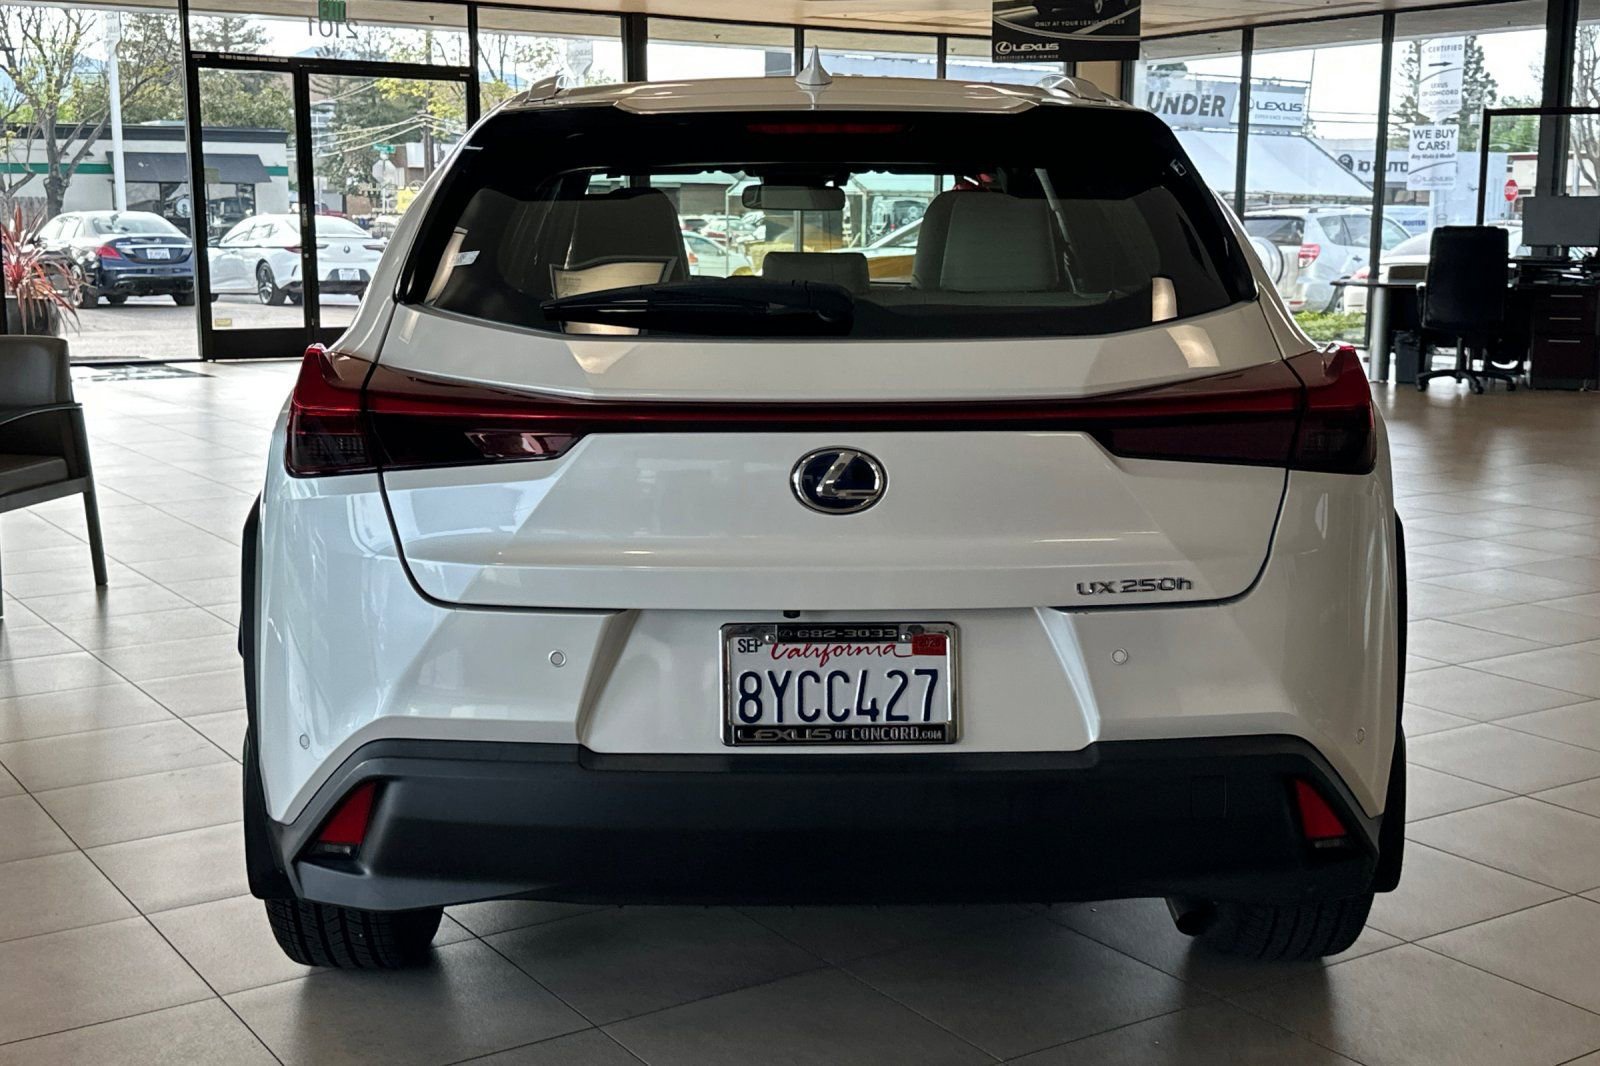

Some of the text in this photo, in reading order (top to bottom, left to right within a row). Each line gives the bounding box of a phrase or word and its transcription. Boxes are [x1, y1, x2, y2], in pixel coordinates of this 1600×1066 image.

[1012, 43, 1060, 52] LEXUS
[1428, 44, 1463, 53] CERTIFIED
[1146, 91, 1226, 117] UNDER
[1256, 101, 1303, 112] LEXUS
[1412, 129, 1457, 139] WE BUY
[1417, 140, 1450, 151] CARS!
[1076, 577, 1192, 595] UX 250h
[797, 629, 898, 639] 682-3033
[737, 638, 763, 653] SEP
[770, 642, 912, 668] California
[738, 669, 939, 723] 8YCC427
[737, 728, 832, 741] LEXUS
[834, 729, 847, 740] OF
